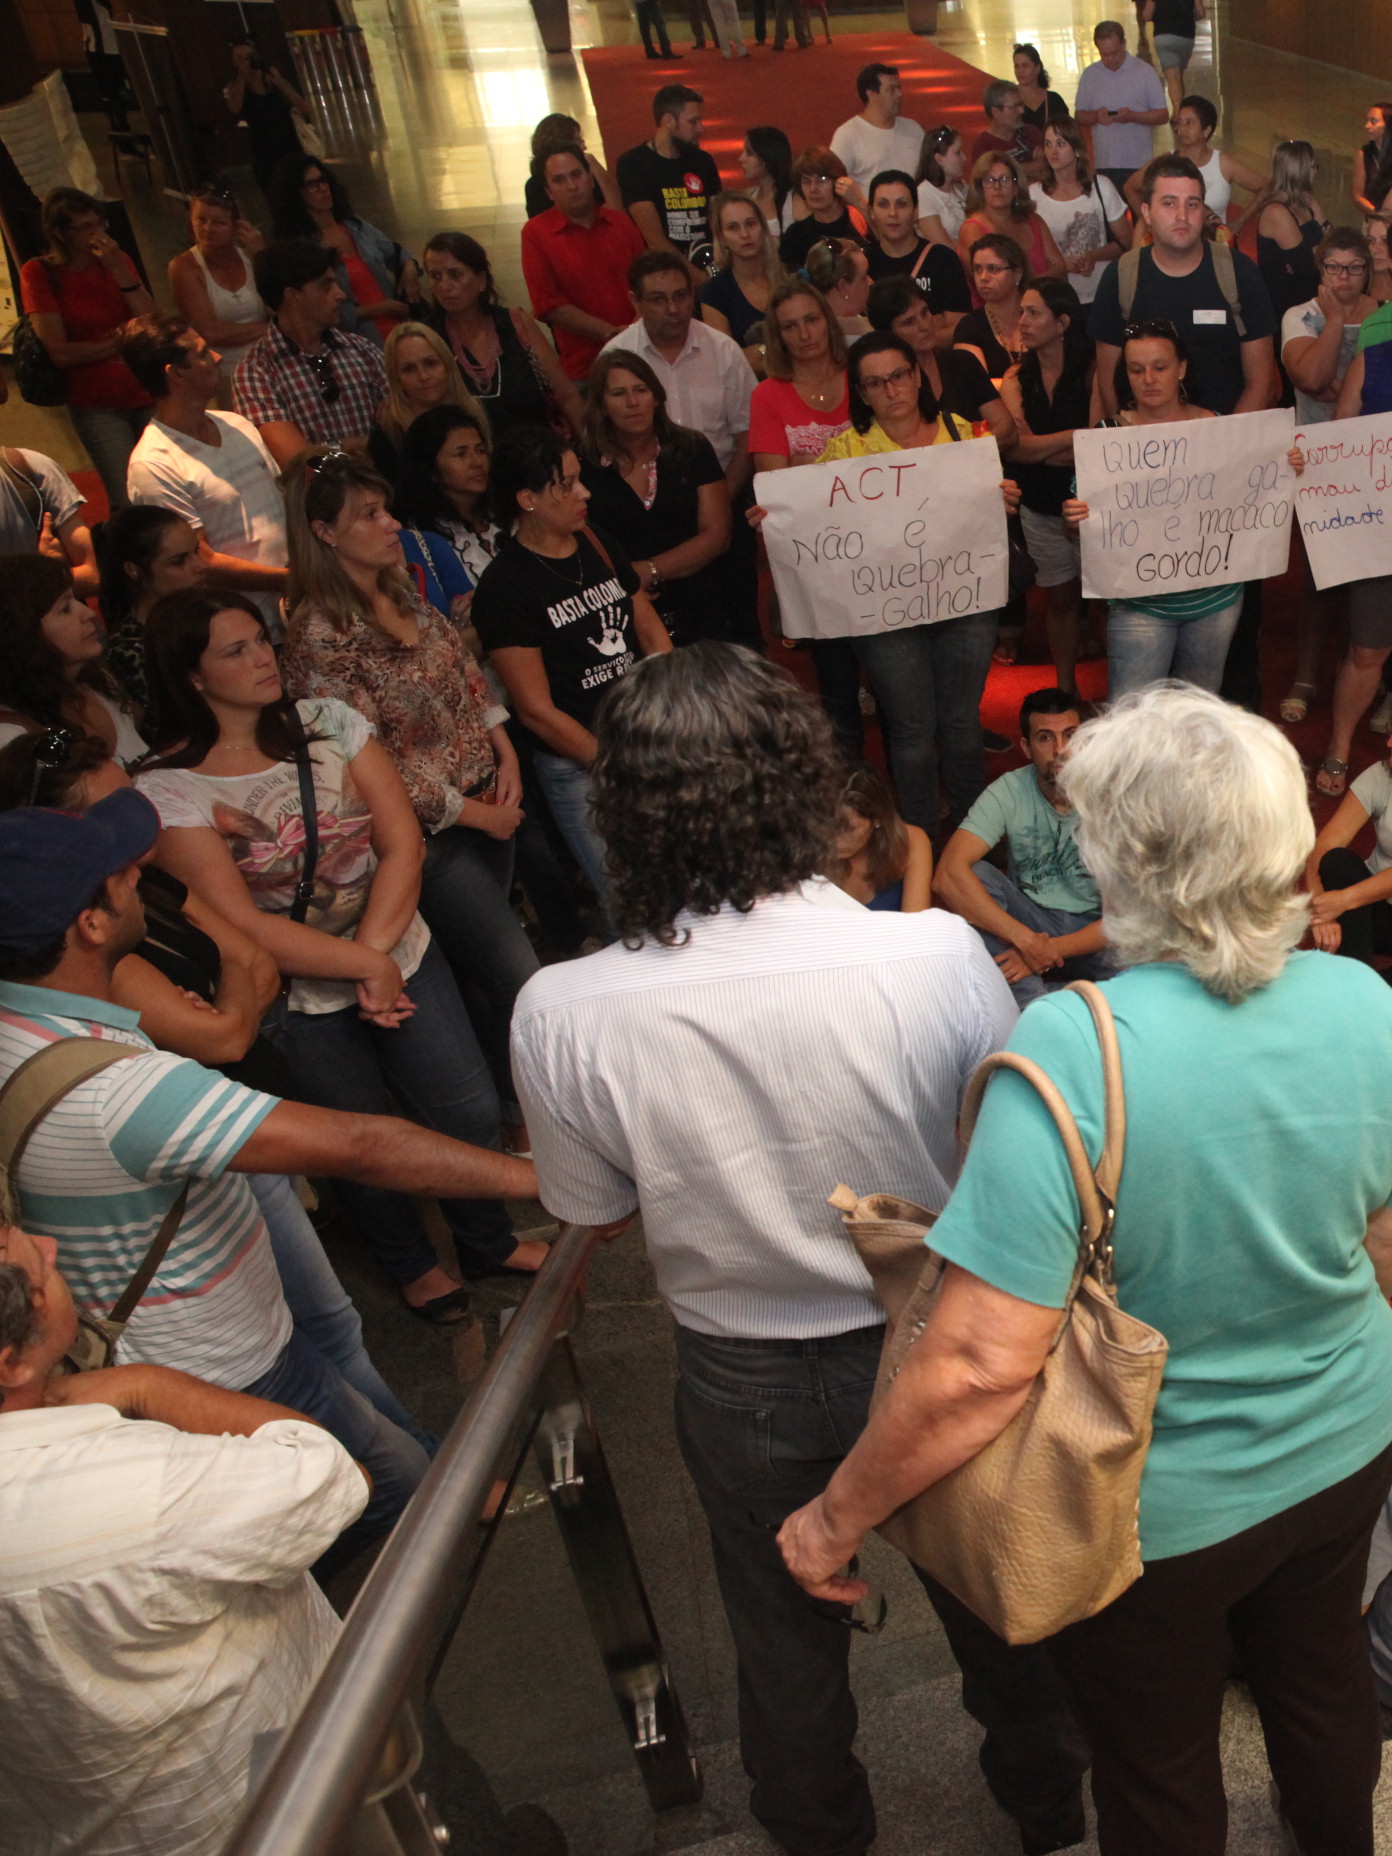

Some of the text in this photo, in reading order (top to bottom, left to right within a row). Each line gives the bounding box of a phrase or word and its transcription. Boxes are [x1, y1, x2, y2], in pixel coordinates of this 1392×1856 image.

[1102, 436, 1188, 473] Quem
[829, 463, 917, 508] ACT
[1243, 460, 1289, 506] ga-
[792, 496, 930, 566] Não é
[1100, 500, 1289, 550] lho é macaco
[1303, 503, 1384, 537] nidade
[1136, 533, 1234, 582] Gordo!
[546, 595, 590, 629] BASTA
[581, 668, 614, 690] EXIGE
[585, 668, 592, 677] O
[242, 785, 268, 817] UNDER
[262, 775, 287, 790] THE
